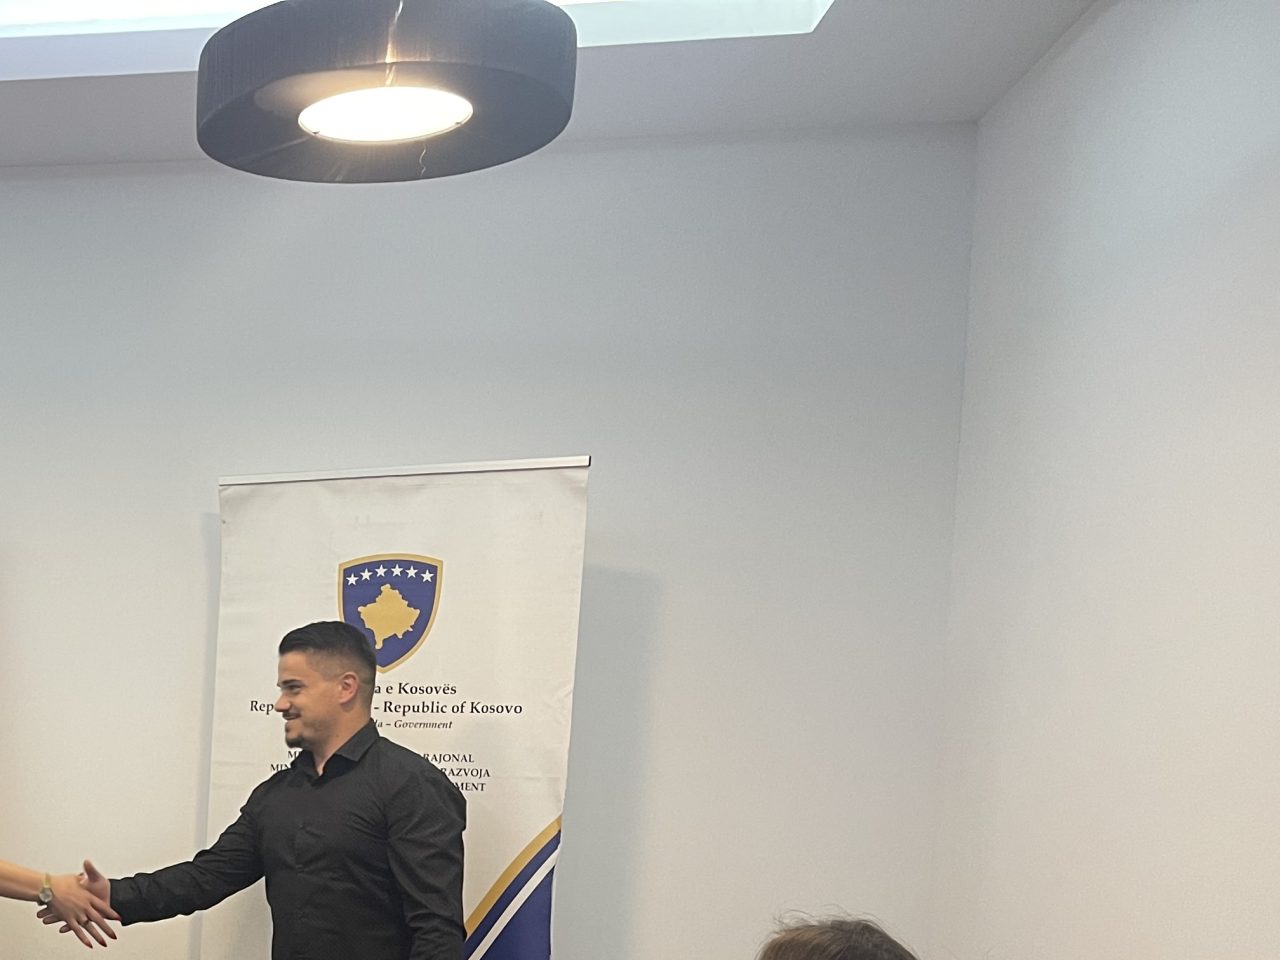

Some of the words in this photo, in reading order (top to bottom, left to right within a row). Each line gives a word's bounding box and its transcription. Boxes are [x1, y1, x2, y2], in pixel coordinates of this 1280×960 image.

[386, 686, 393, 694] e
[398, 682, 457, 695] Kosovës
[250, 700, 274, 715] Rep
[383, 701, 448, 716] Republic
[451, 701, 466, 714] of
[469, 701, 523, 714] Kosovo
[394, 719, 453, 729] Government
[423, 753, 475, 764] RAJONAL
[440, 767, 491, 779] RAZVOJA
[455, 782, 487, 792] MENT
